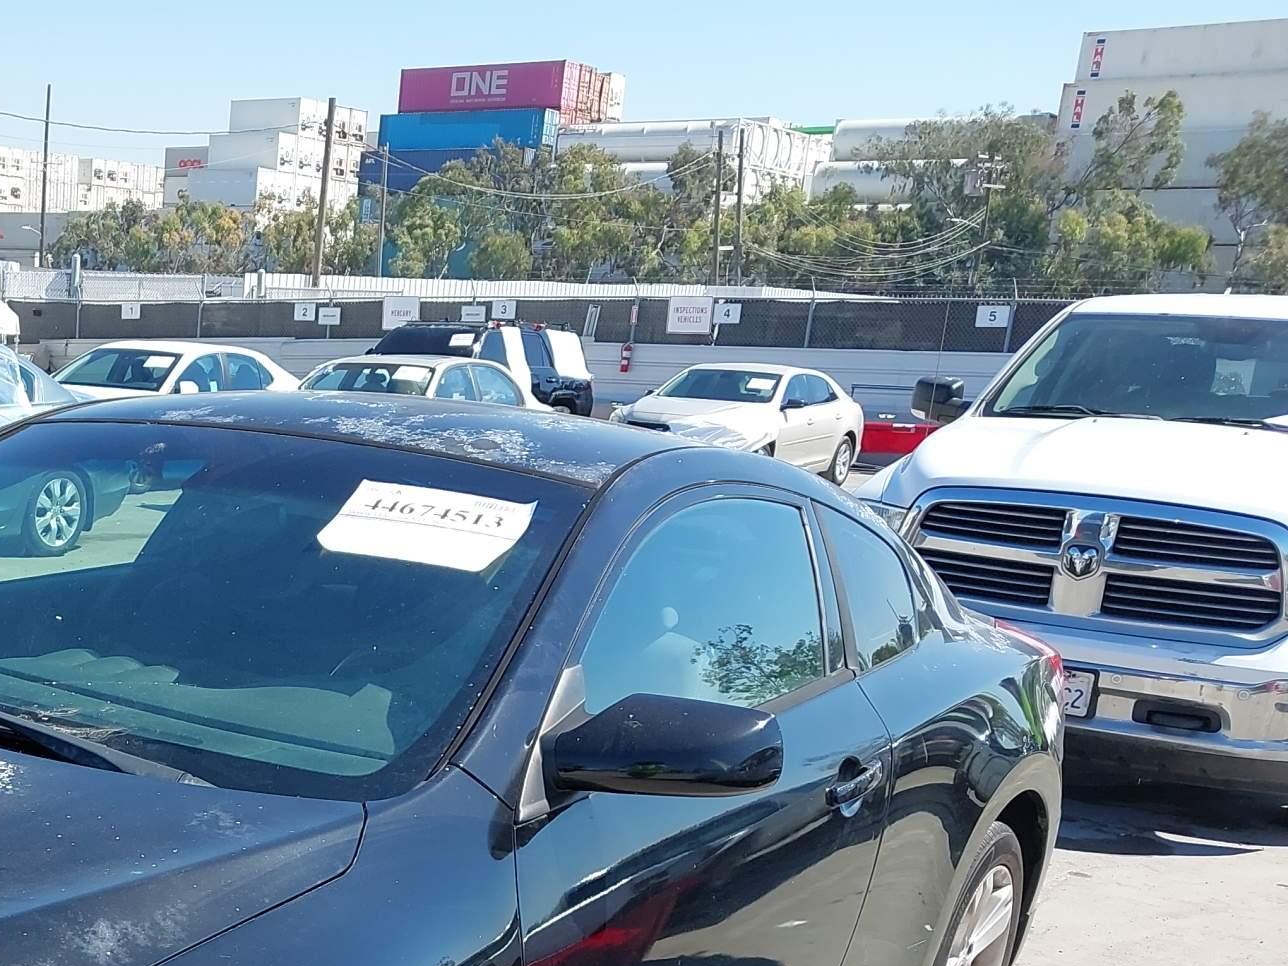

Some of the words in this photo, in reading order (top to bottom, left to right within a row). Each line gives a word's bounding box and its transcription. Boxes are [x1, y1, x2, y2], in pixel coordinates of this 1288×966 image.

[1091, 44, 1105, 71] TAL
[450, 70, 509, 97] ONE
[1072, 96, 1086, 122] TAL
[128, 306, 134, 315] 1
[302, 307, 308, 317] 2
[391, 309, 412, 318] MERCURY
[501, 304, 507, 314] 3
[673, 306, 708, 315] INSPECTIONS
[723, 308, 730, 319] 4
[677, 315, 702, 324] VEHICLES
[988, 310, 998, 322] 5
[364, 498, 504, 529] 44674513
